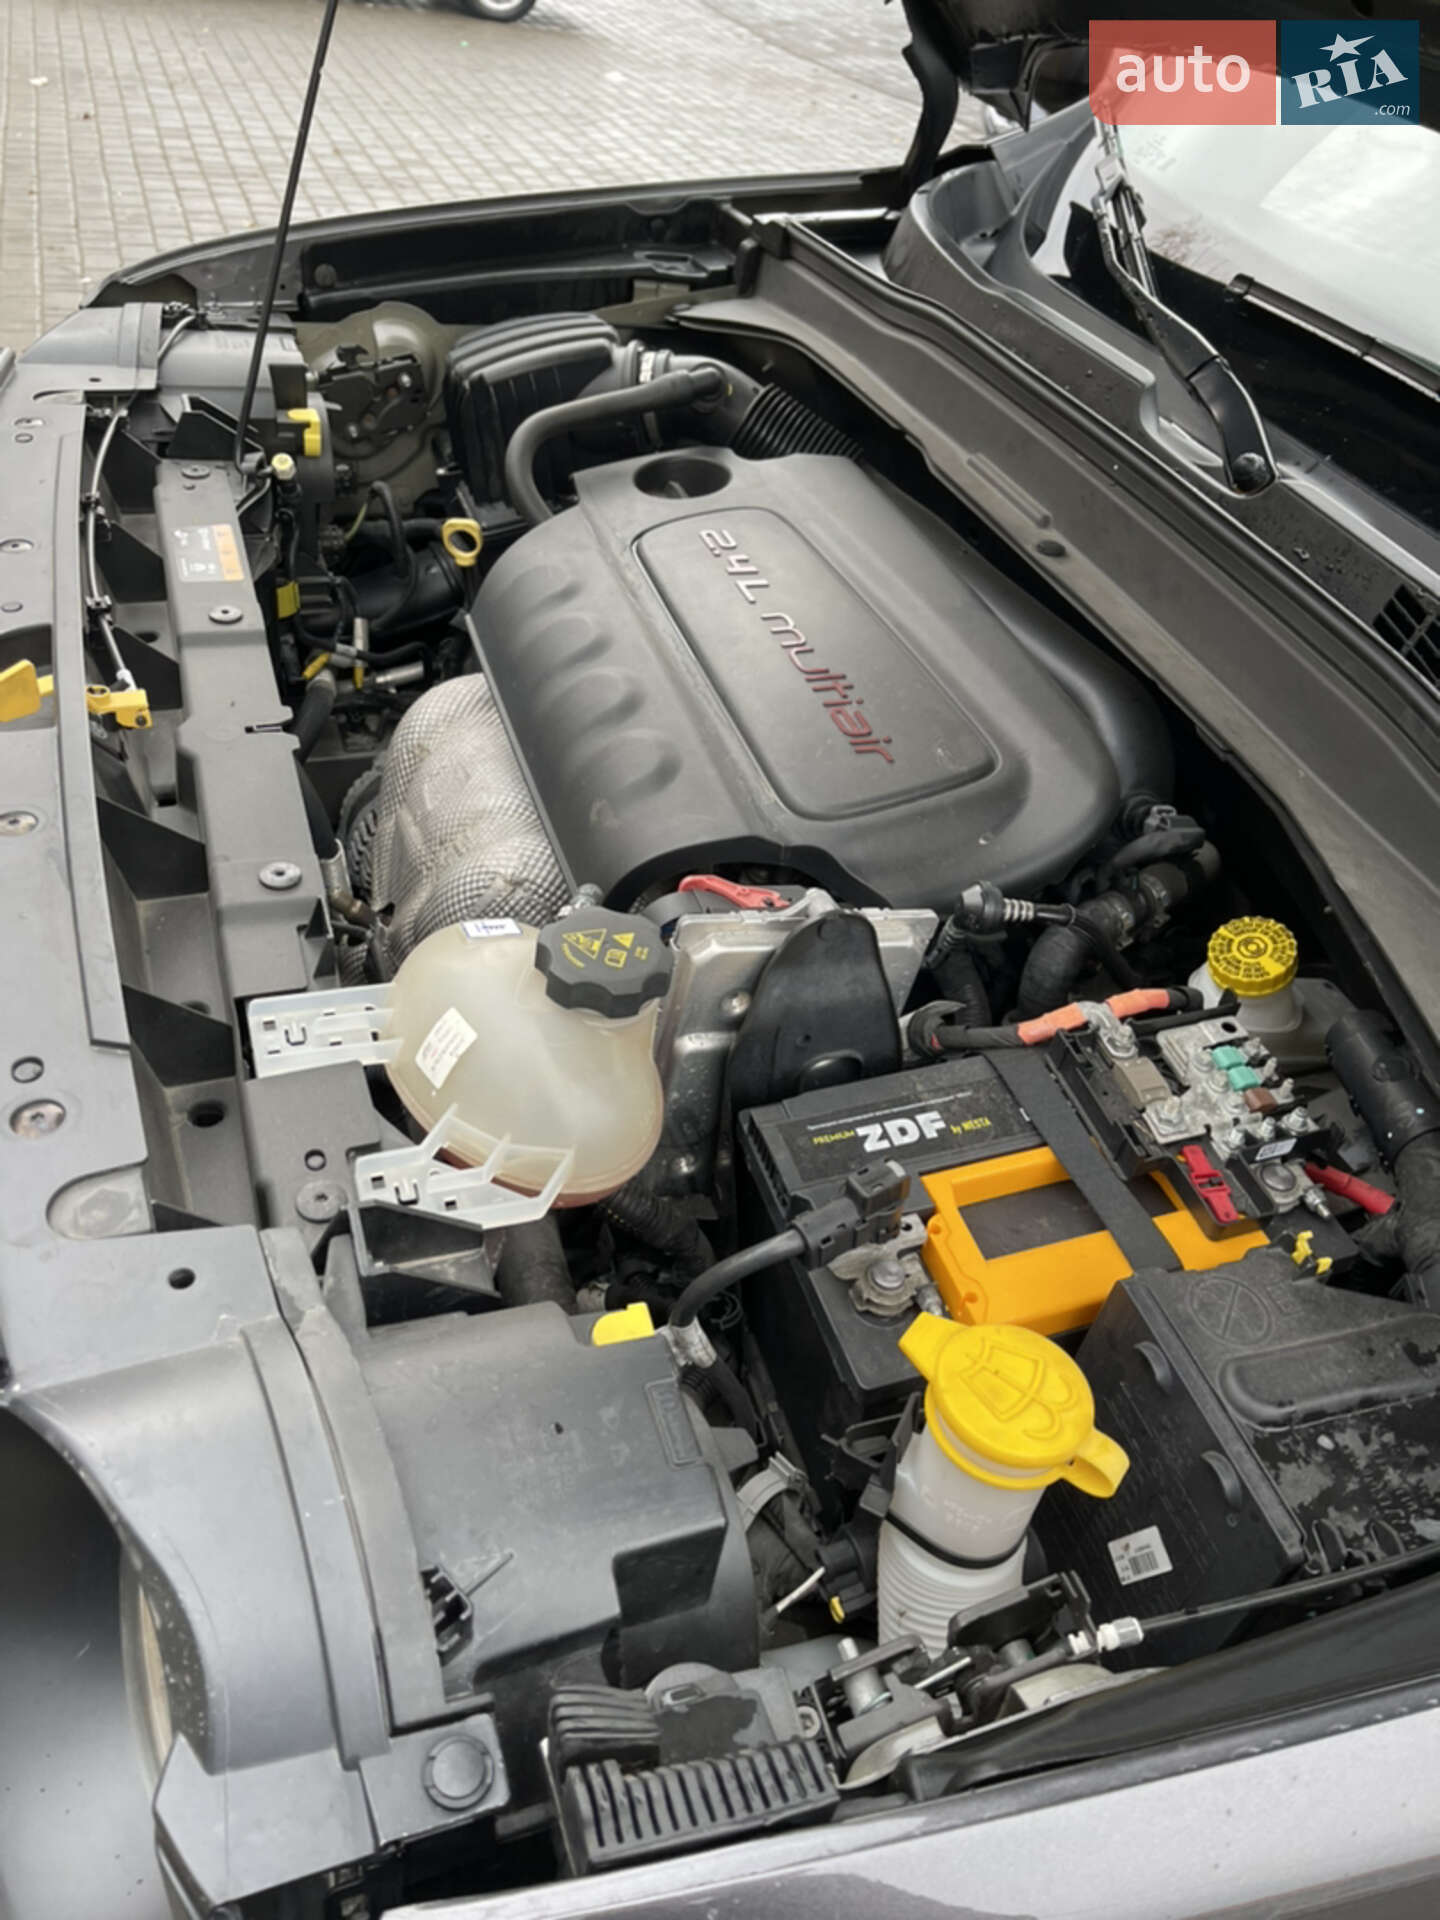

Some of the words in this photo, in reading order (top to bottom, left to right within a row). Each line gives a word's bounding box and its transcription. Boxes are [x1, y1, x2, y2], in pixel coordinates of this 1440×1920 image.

[700, 529, 770, 604] 2.4L
[760, 612, 894, 763] multiair
[855, 1110, 946, 1153] ZDF
